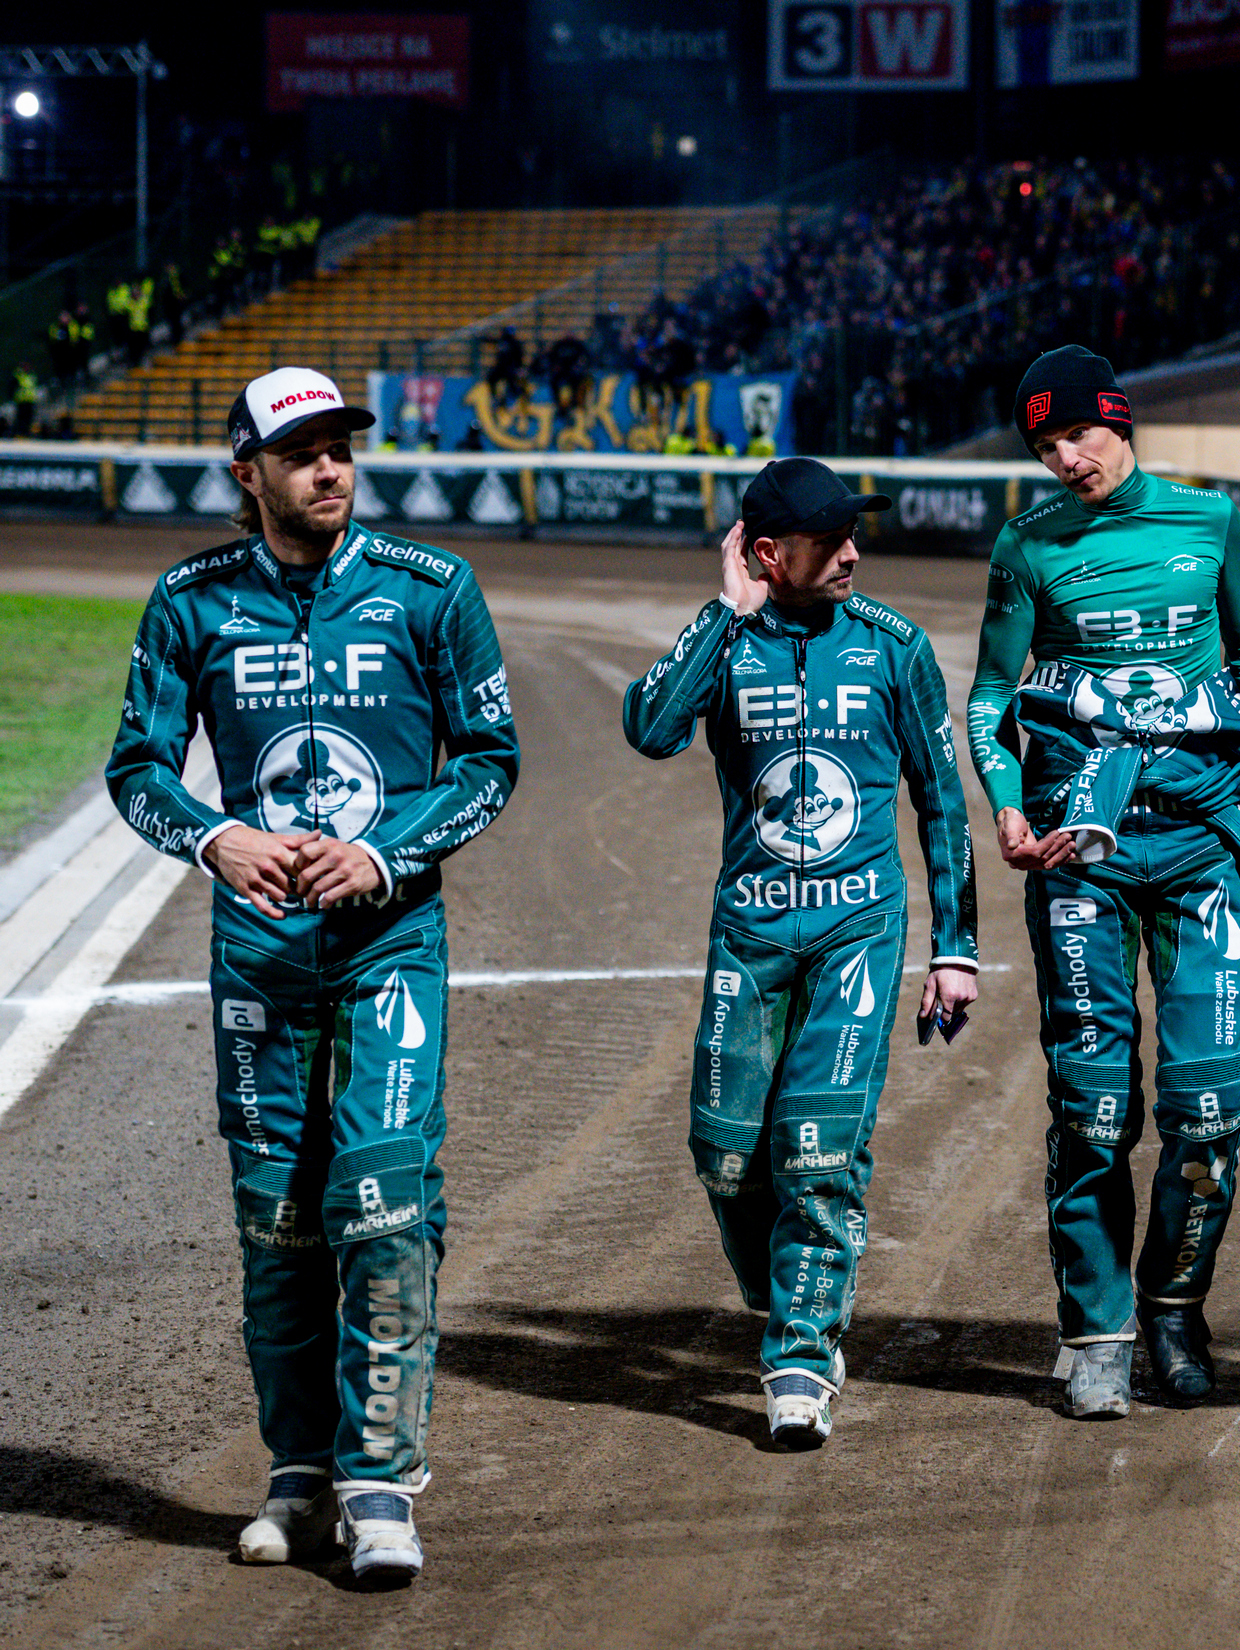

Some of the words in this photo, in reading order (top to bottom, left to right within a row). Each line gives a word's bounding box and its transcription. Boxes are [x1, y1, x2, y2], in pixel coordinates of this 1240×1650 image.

[270, 390, 336, 413] MOLDOW
[1170, 485, 1223, 499] Stelmet
[1017, 501, 1064, 528] CANAL+
[165, 548, 246, 586] CANAL+
[332, 533, 368, 577] MOLDOW
[369, 538, 456, 580] Stelmet
[1173, 562, 1197, 573] PGE
[359, 608, 395, 622] PGE
[849, 595, 915, 638] Stelmet
[845, 656, 877, 666] PGE
[1081, 638, 1195, 652] DEVELOPMENT
[235, 694, 389, 711] DEVELOPMENT
[740, 729, 870, 743] DEVELOPMENT
[733, 869, 880, 909] Stelmet
[1061, 932, 1097, 1054] samochody
[1214, 971, 1224, 999] Warte
[1214, 1001, 1223, 1045] zachodu
[1225, 969, 1238, 1046] Lubuskie
[709, 1000, 731, 1108] samochody
[837, 1024, 851, 1049] Warte
[839, 1023, 864, 1086] Lubuskie
[385, 1060, 398, 1090] Warte
[830, 1049, 845, 1085] zachodu
[383, 1091, 395, 1130] zachodu
[395, 1057, 416, 1130] Lubuskie
[1067, 1121, 1132, 1140] AMRHEIN
[784, 1151, 847, 1169] AMRHEIN
[343, 1204, 419, 1237] AMRHEIN
[810, 1195, 840, 1318] Mercedes-Benz
[1172, 1201, 1209, 1284] BETKOM
[790, 1246, 814, 1314] WRÓBEL
[362, 1279, 400, 1460] MOLDOW
